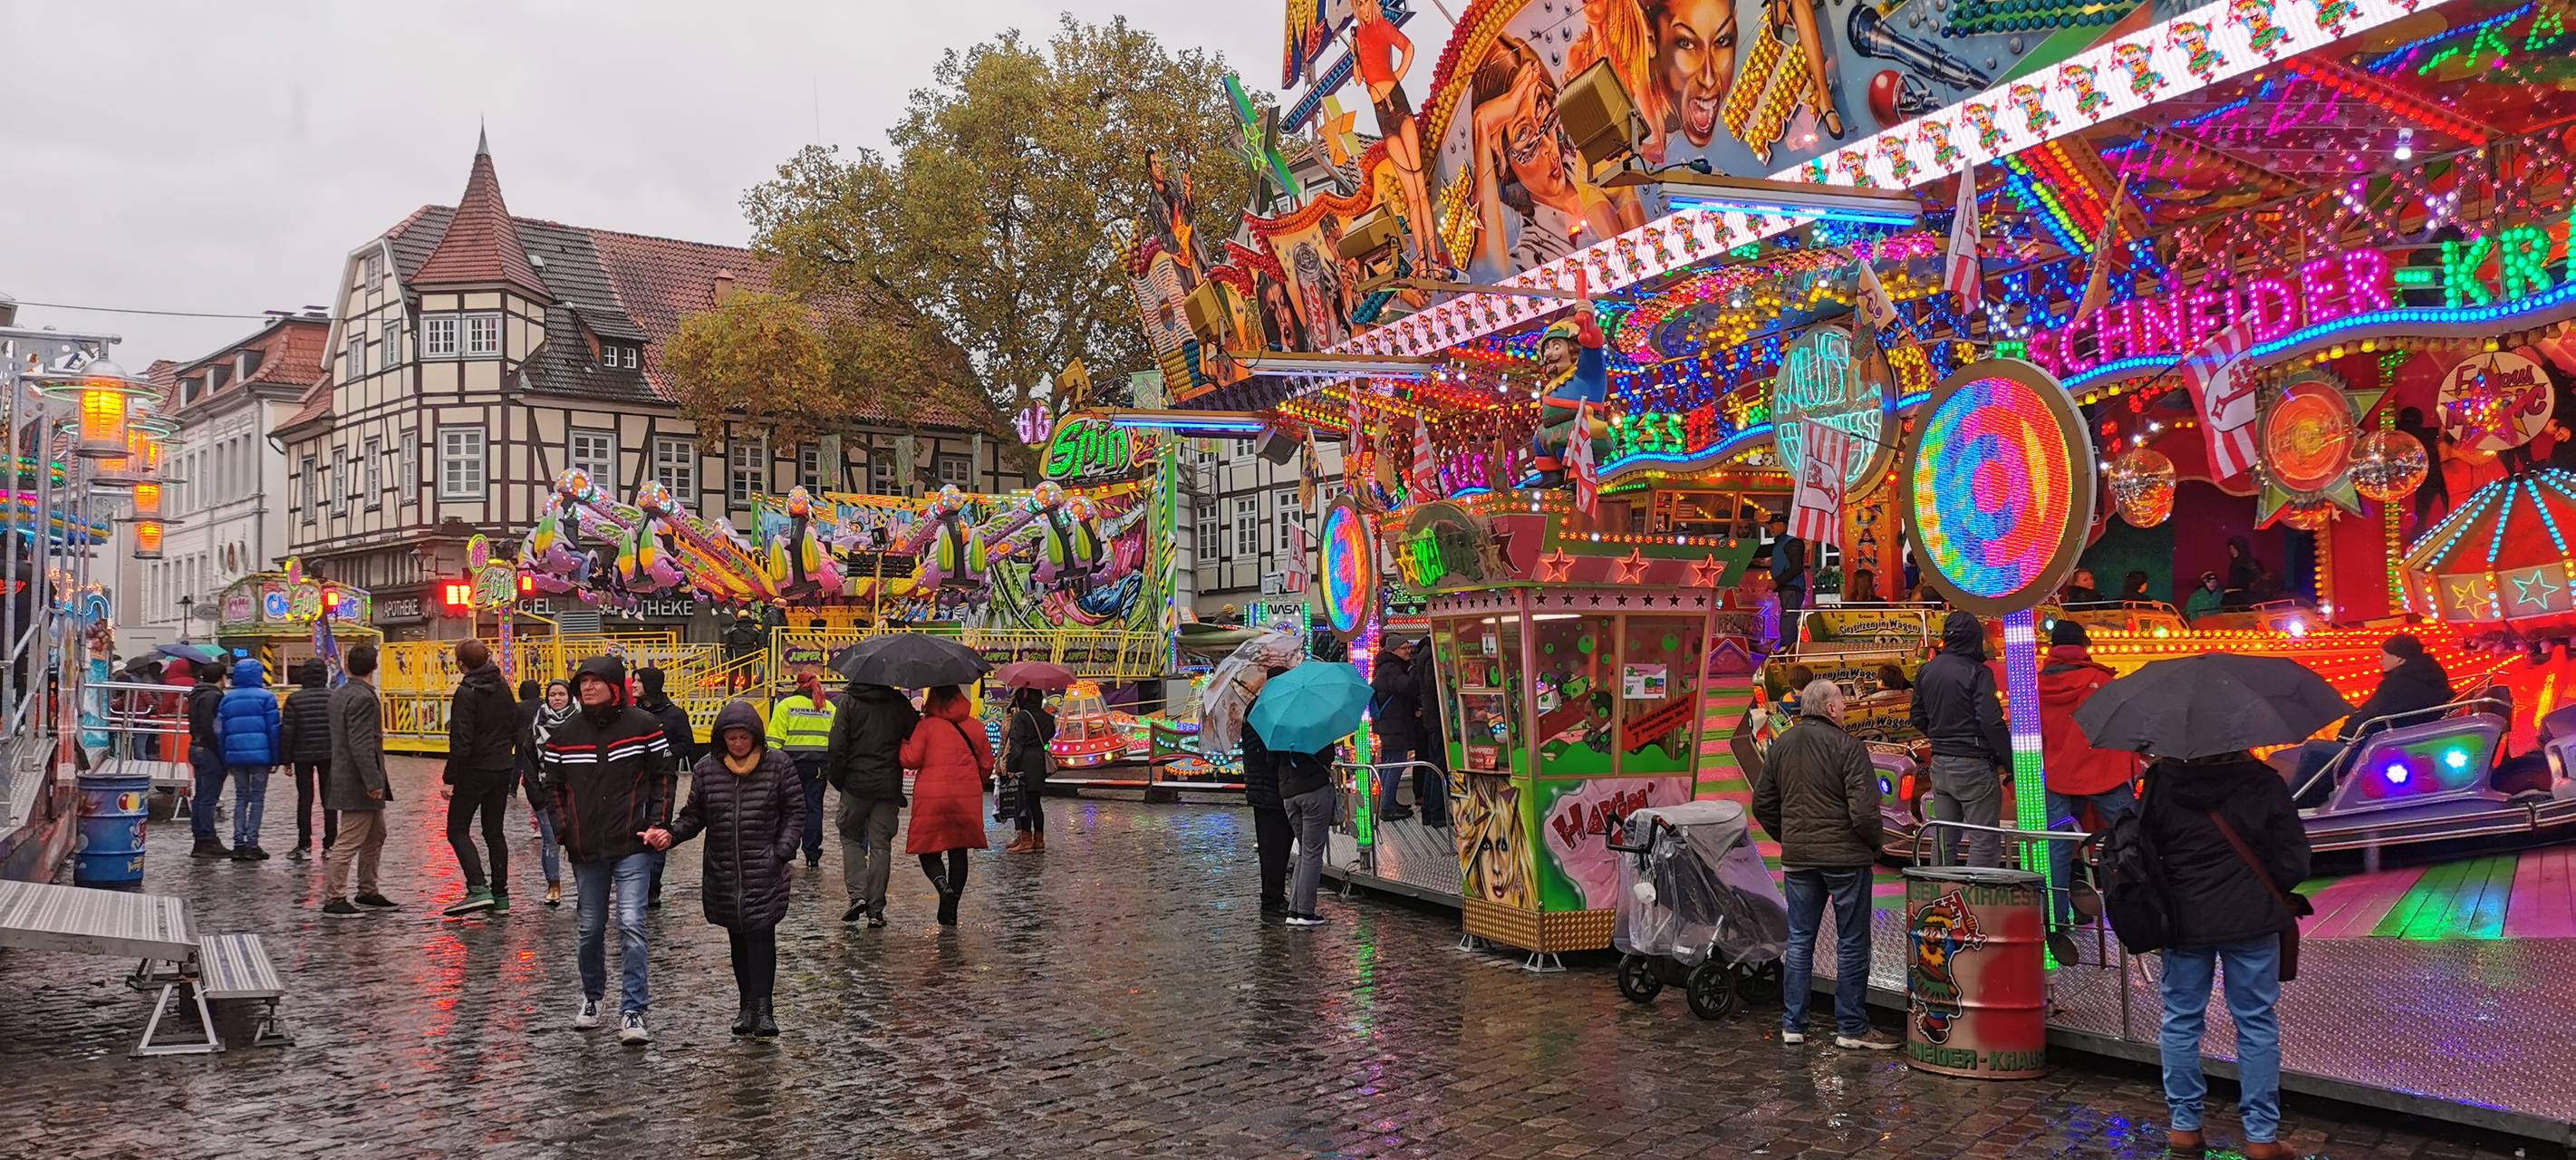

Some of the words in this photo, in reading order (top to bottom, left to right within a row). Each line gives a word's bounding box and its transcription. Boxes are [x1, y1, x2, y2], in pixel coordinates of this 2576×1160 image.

[2026, 203, 2576, 379] SCHNEIDER-KR
[2455, 363, 2534, 399] Fous
[1047, 420, 1126, 478] Spin
[384, 598, 419, 617] APOTHEKE
[1267, 604, 1301, 615] NASA
[1889, 618, 1918, 633] Wagen
[789, 651, 821, 662] JUMPER
[1849, 667, 1877, 680] Wage
[1960, 886, 2036, 906] KIRMES
